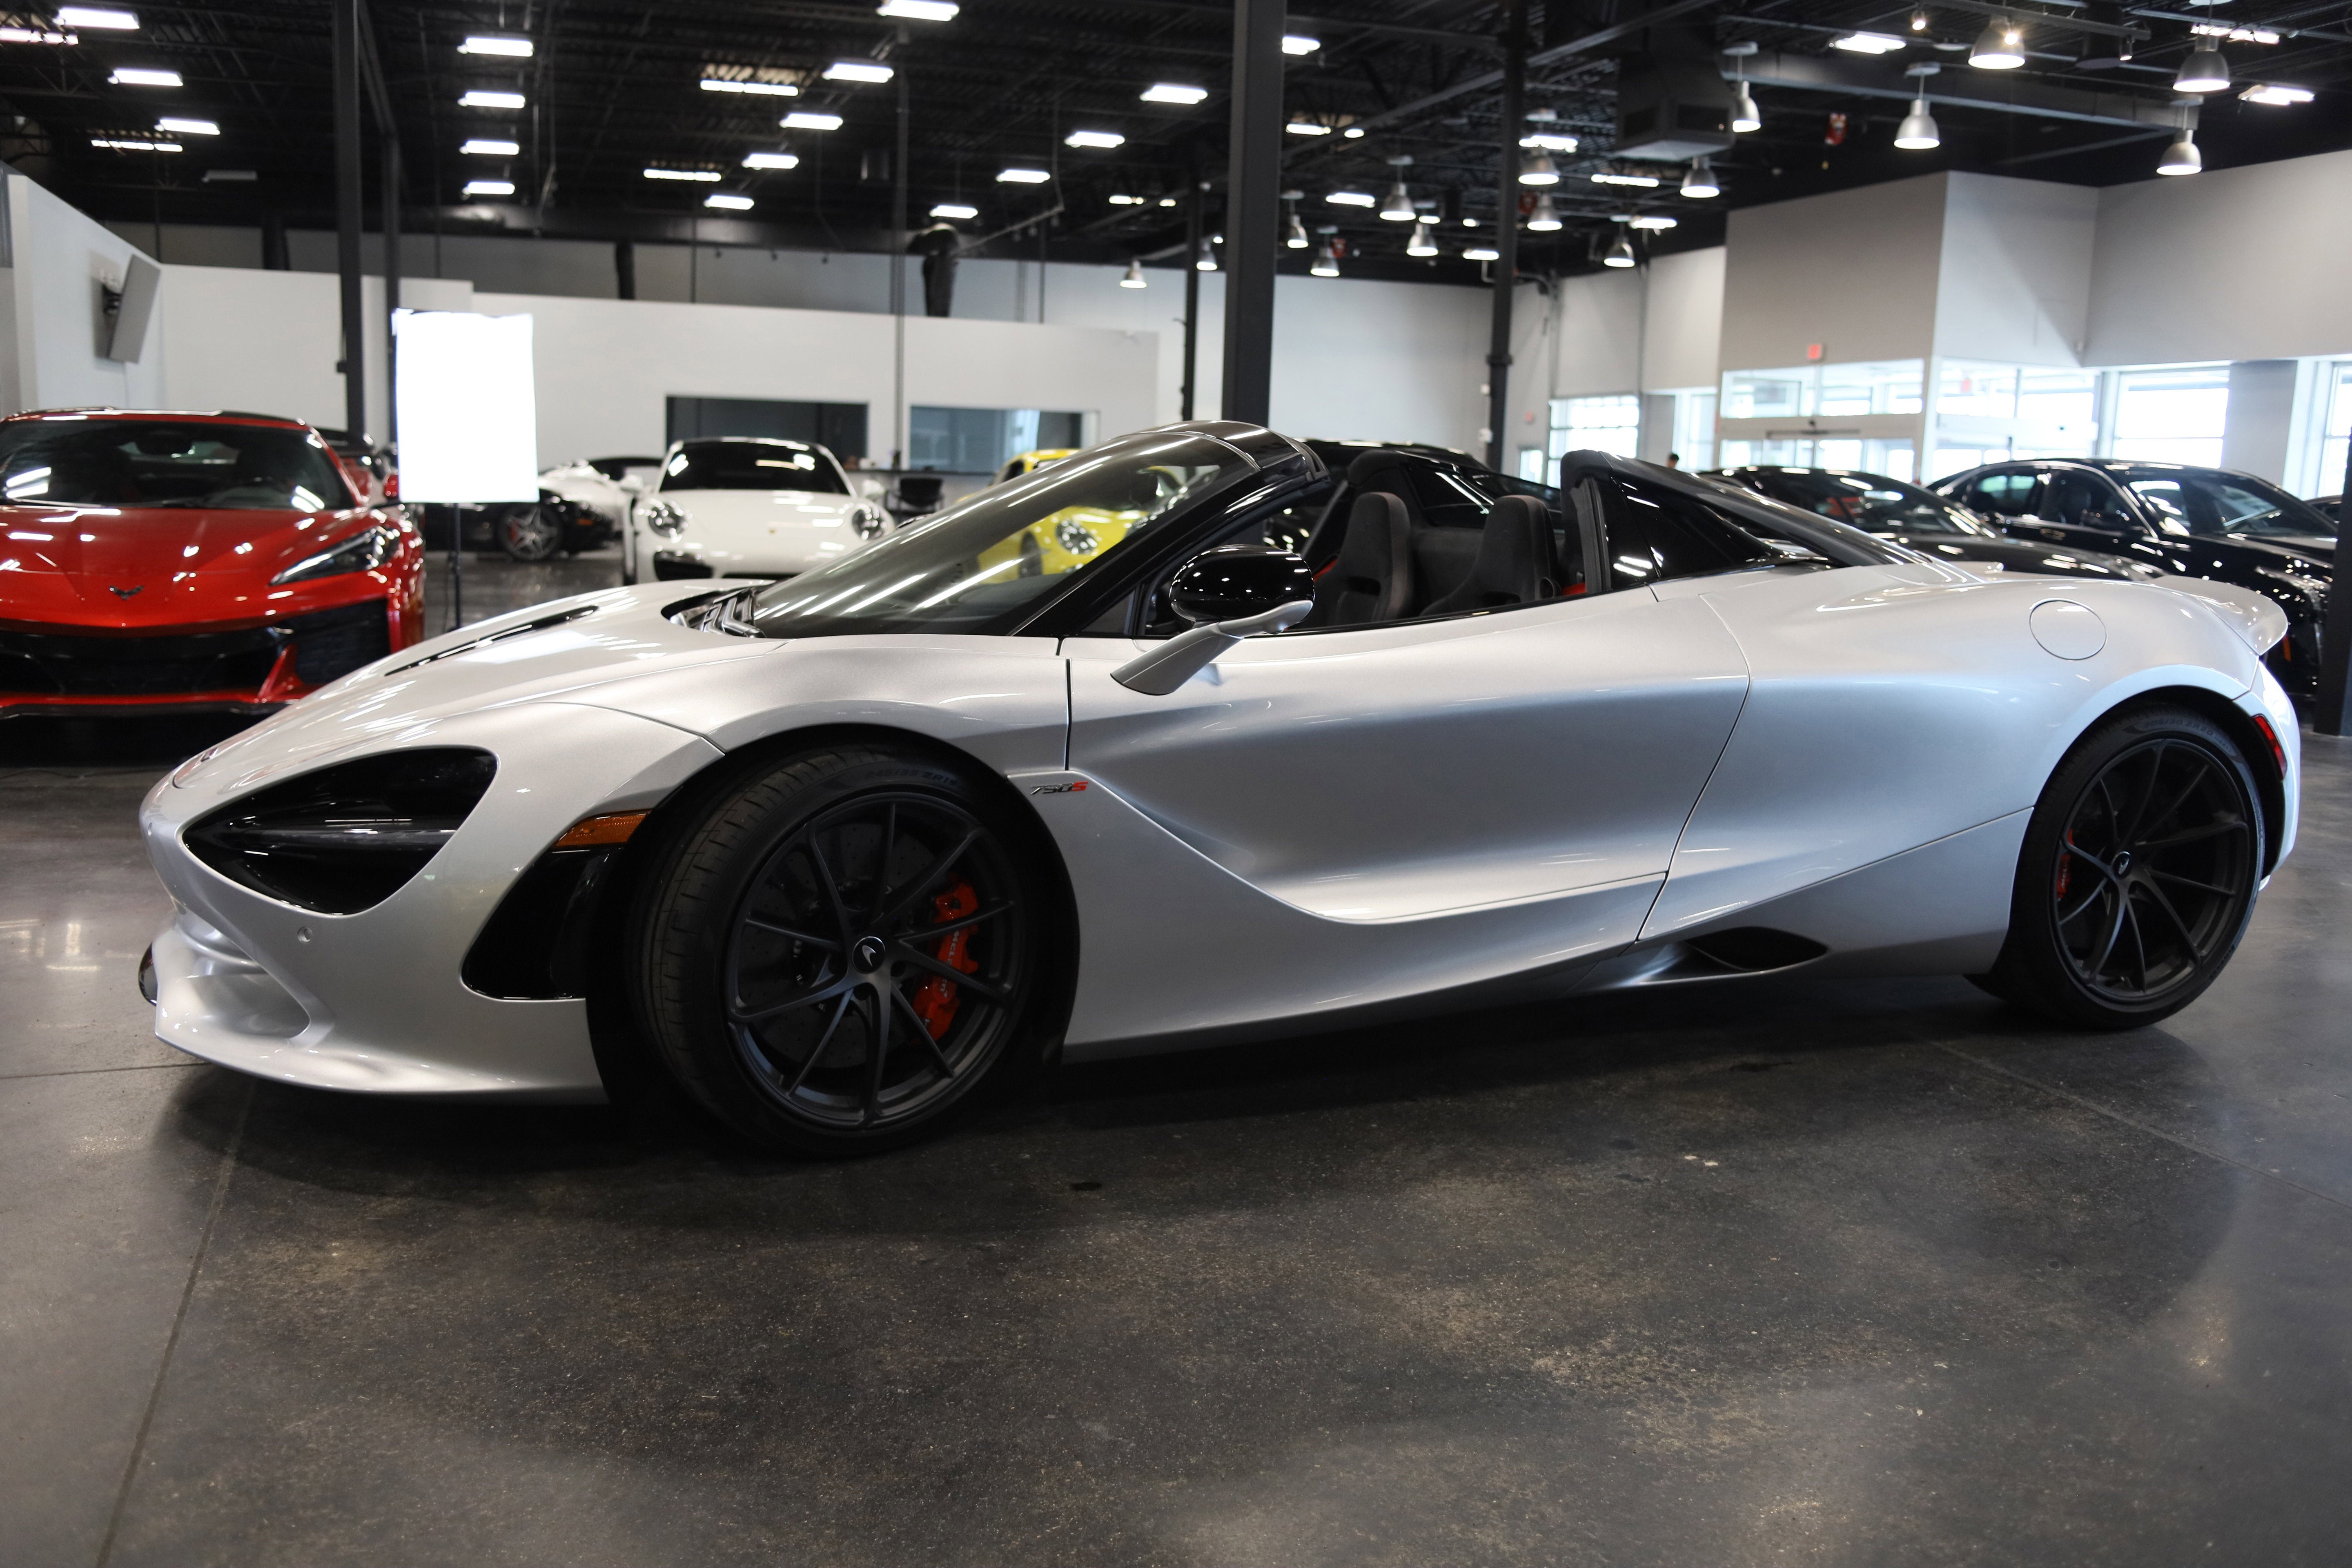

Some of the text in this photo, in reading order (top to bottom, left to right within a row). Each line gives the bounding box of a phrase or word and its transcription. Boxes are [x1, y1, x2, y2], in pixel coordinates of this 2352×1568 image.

[2185, 721, 2213, 736] ZR20
[864, 768, 920, 779] 245/35
[1030, 781, 1089, 795] 750S
